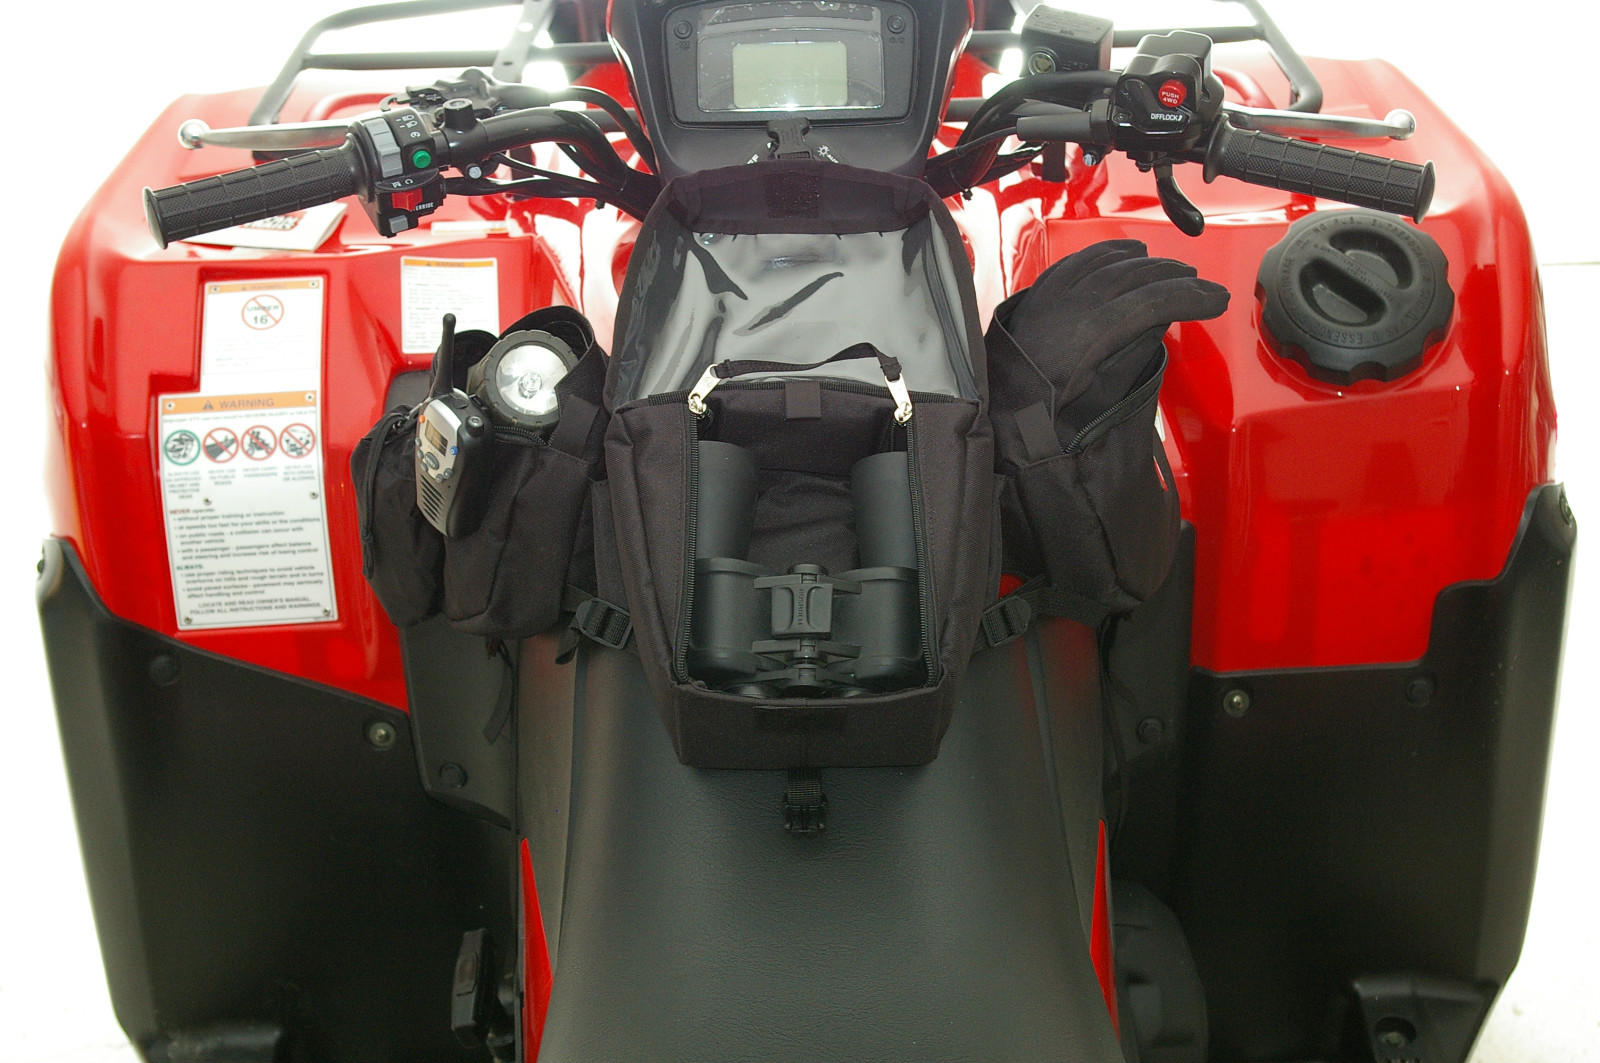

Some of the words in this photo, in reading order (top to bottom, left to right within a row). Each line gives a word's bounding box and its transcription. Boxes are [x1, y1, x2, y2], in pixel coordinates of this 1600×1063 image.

[1162, 91, 1180, 99] PUSH
[1150, 112, 1178, 121] DIFFLOCK
[253, 314, 268, 324] 16
[219, 398, 274, 409] WARNING
